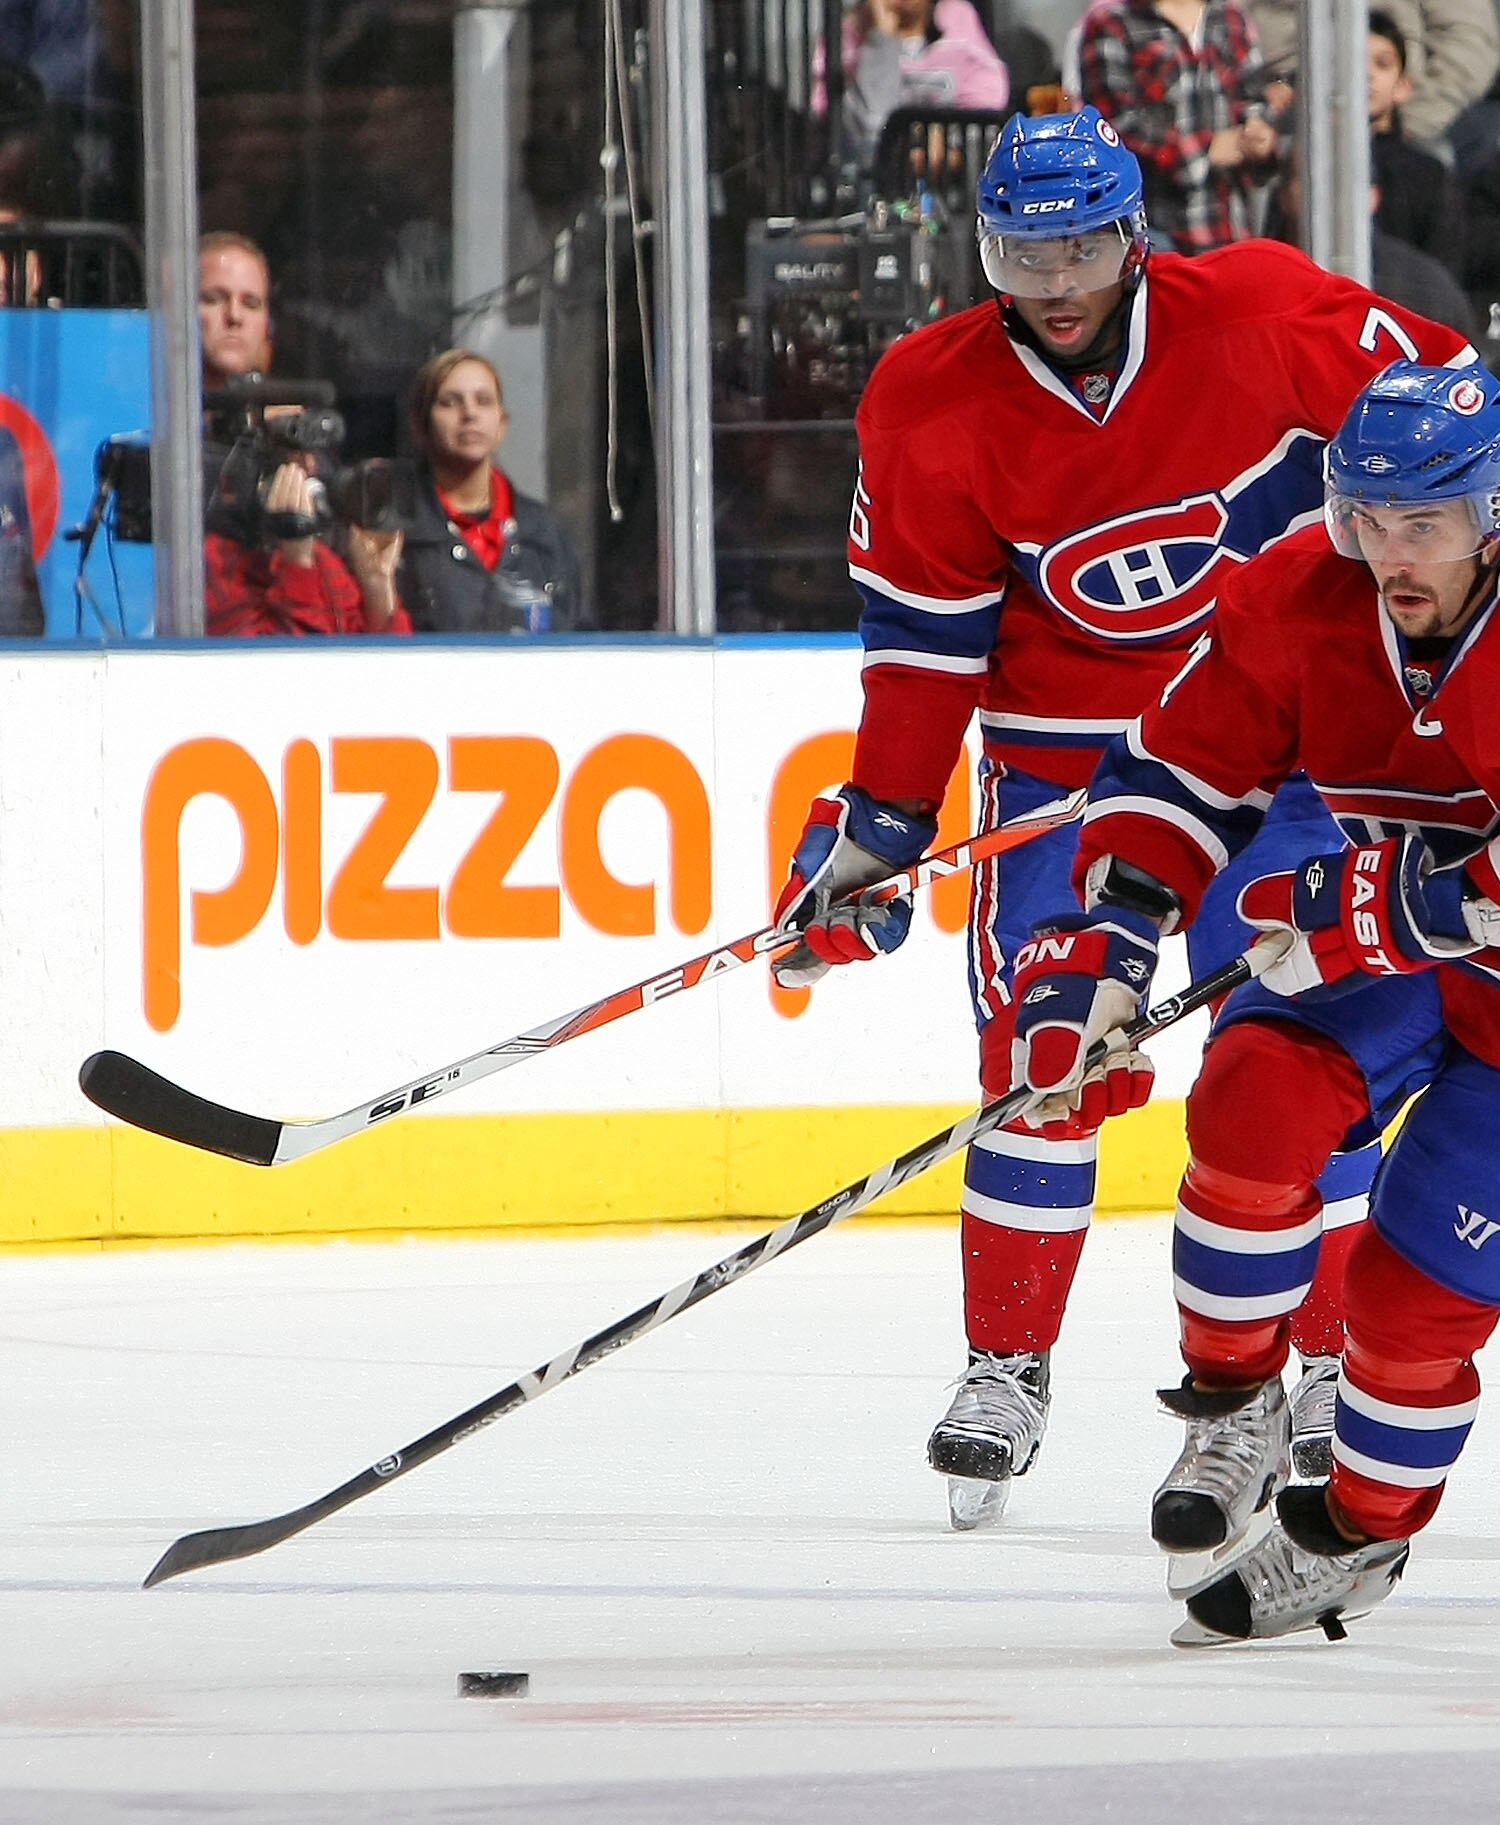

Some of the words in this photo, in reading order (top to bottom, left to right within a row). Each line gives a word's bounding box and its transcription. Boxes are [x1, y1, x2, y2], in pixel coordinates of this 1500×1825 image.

[1022, 197, 1076, 215] CCM
[1359, 306, 1420, 363] 7
[140, 731, 712, 1033] pizza
